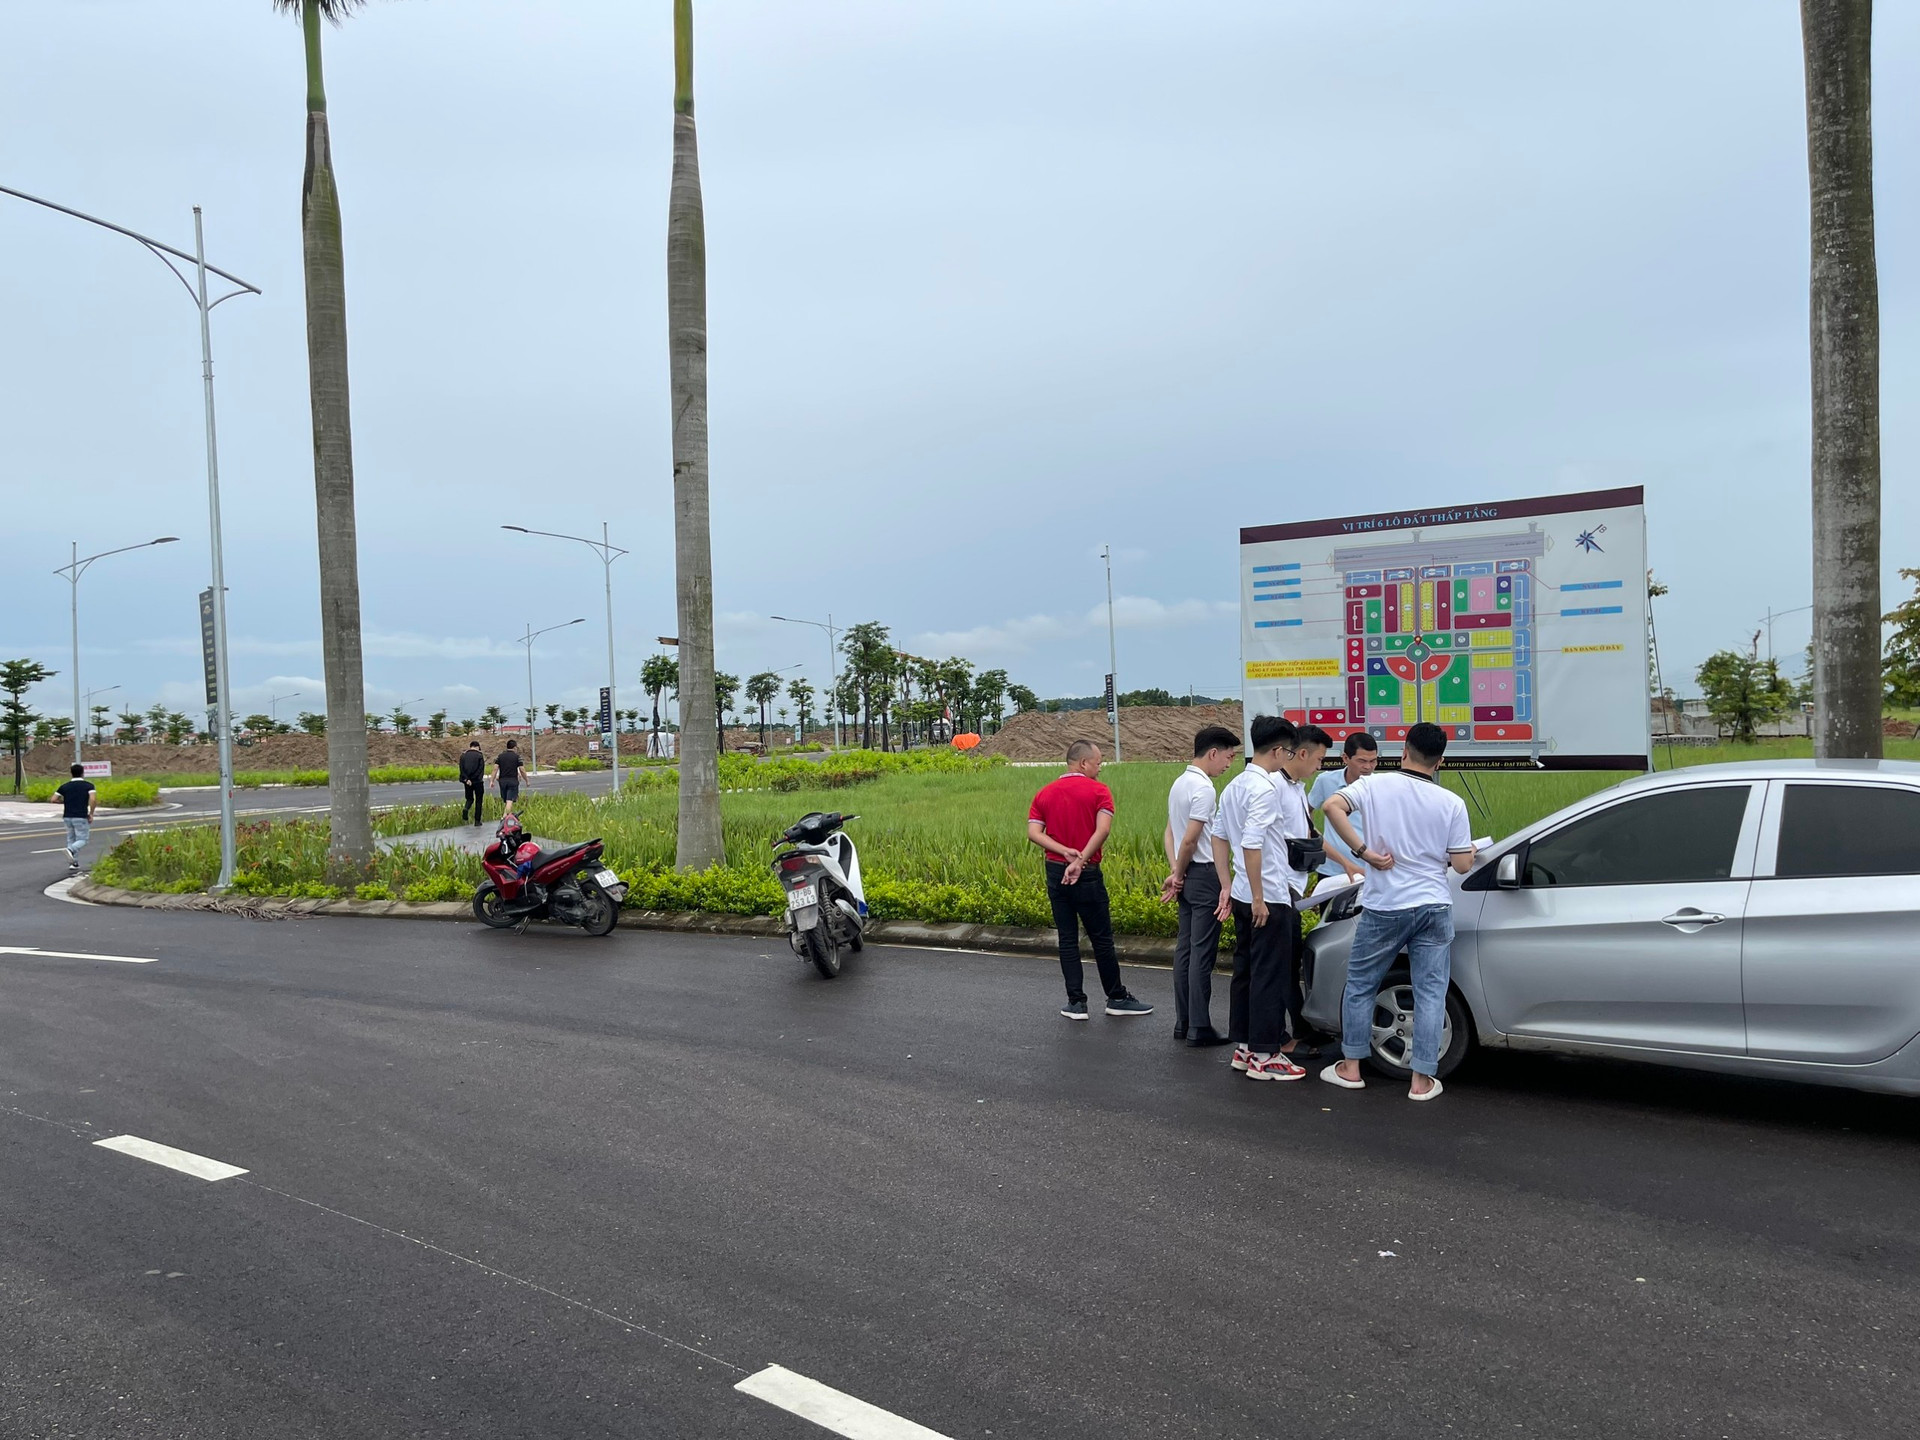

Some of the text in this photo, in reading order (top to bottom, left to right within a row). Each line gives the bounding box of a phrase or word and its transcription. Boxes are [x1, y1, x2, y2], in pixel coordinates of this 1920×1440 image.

[1342, 506, 1498, 532] VỊ TRÍ 6 LÔ ĐẤT THẤP TẦNG
